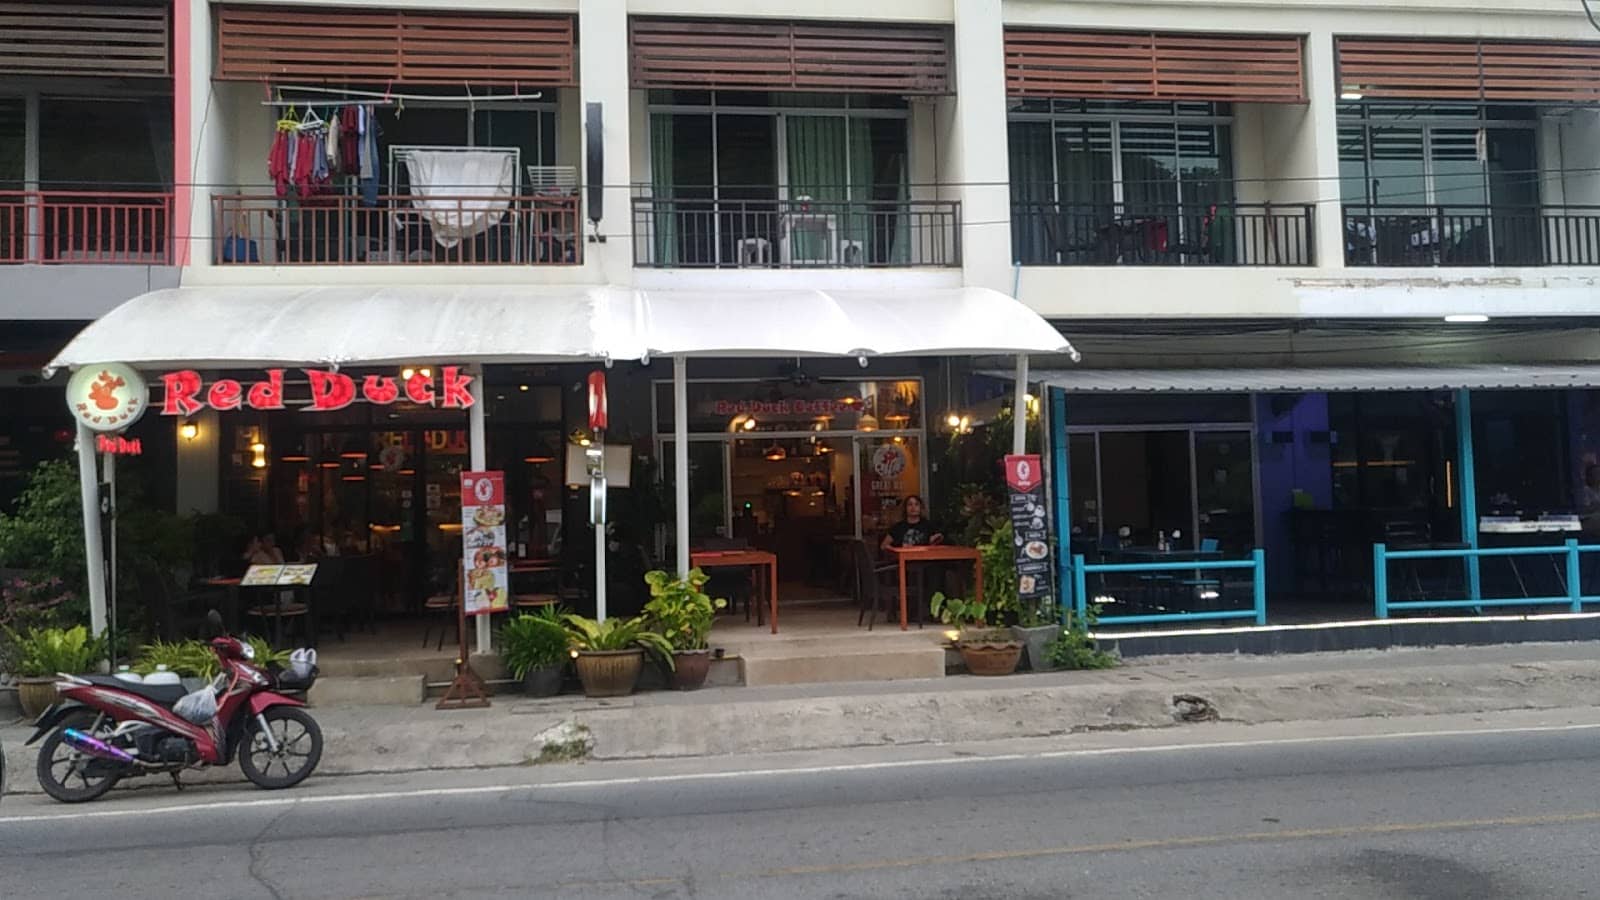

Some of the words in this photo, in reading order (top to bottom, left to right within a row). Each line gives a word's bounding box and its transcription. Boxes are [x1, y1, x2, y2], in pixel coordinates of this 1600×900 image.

[160, 368, 287, 416] Red
[299, 365, 475, 412] Duck
[76, 402, 102, 424] Red
[108, 397, 139, 424] Duck
